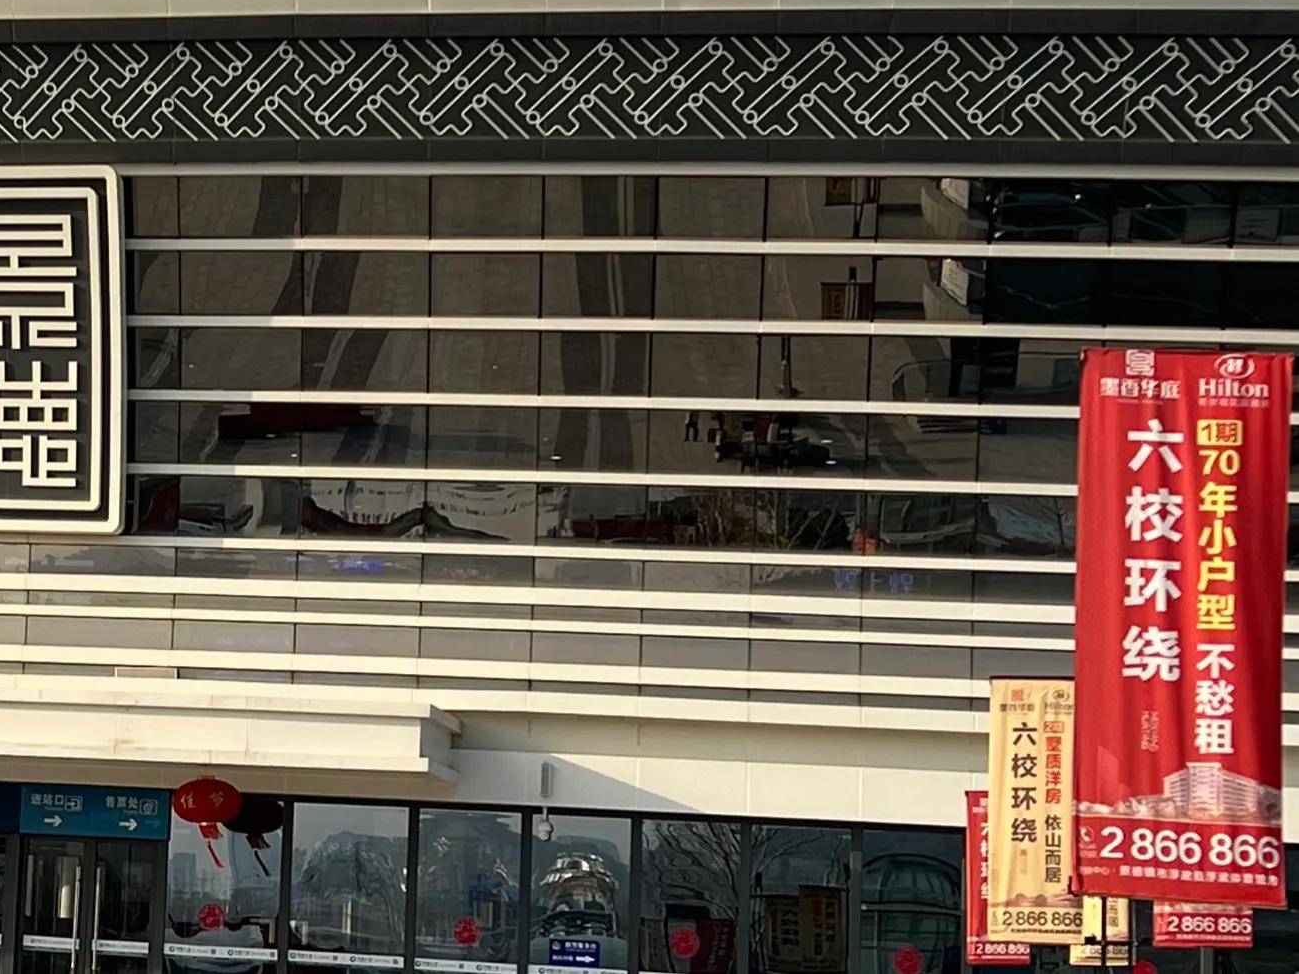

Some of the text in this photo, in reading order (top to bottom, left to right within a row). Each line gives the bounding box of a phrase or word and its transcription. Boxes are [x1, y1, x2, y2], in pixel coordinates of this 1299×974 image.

[1198, 378, 1269, 398] Hilton
[1201, 422, 1238, 442] 1期
[1122, 418, 1184, 682] 六校环绕
[1194, 643, 1235, 754] 不愁租
[105, 795, 139, 810] 售票处
[1011, 721, 1037, 843] 六校环绕
[1045, 814, 1062, 883] 依山而居
